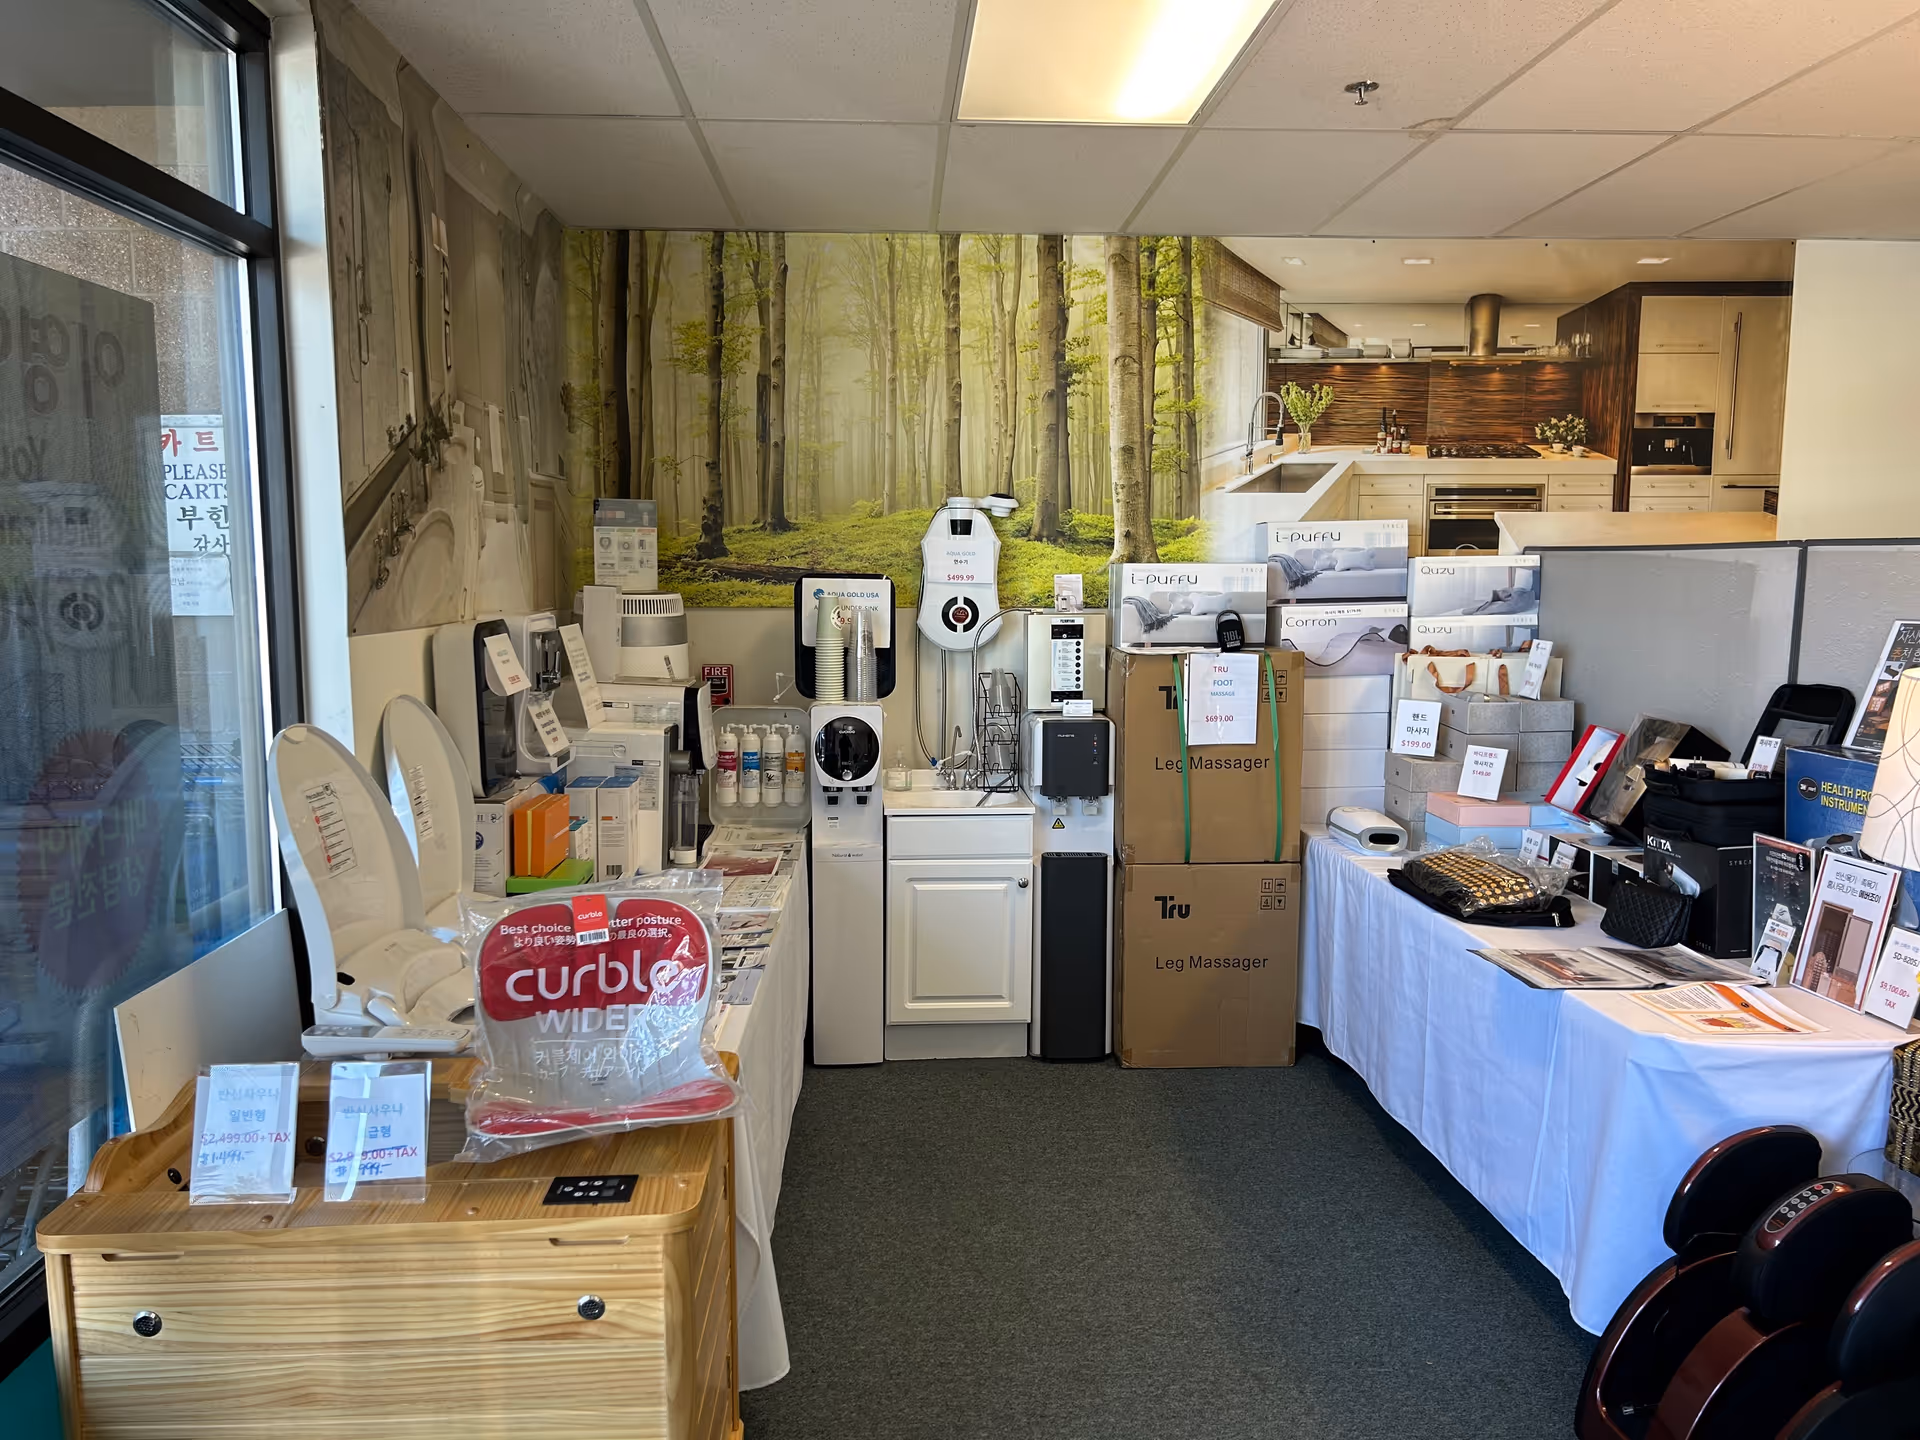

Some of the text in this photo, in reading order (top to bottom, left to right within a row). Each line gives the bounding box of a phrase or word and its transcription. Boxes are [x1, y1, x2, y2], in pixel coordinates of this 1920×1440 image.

[947, 574, 975, 582] $499.99
[1285, 616, 1337, 628] Corron
[704, 667, 729, 676] FIRE
[1213, 679, 1233, 687] FOOT
[1205, 715, 1234, 723] $699.00
[1406, 726, 1430, 736] 마사지
[1401, 739, 1432, 749] $199.00
[1155, 755, 1270, 773] Leg Massager
[1472, 769, 1491, 777] $149.00
[1821, 781, 1854, 799] HEALTH
[1154, 895, 1191, 920] Tru
[577, 910, 603, 920] curble
[500, 924, 529, 936] Best
[531, 922, 571, 935] choice
[1155, 955, 1268, 973] Leg Massager
[505, 950, 679, 1002] curble
[1884, 998, 1897, 1010] TAX
[229, 1109, 266, 1123] 일반형
